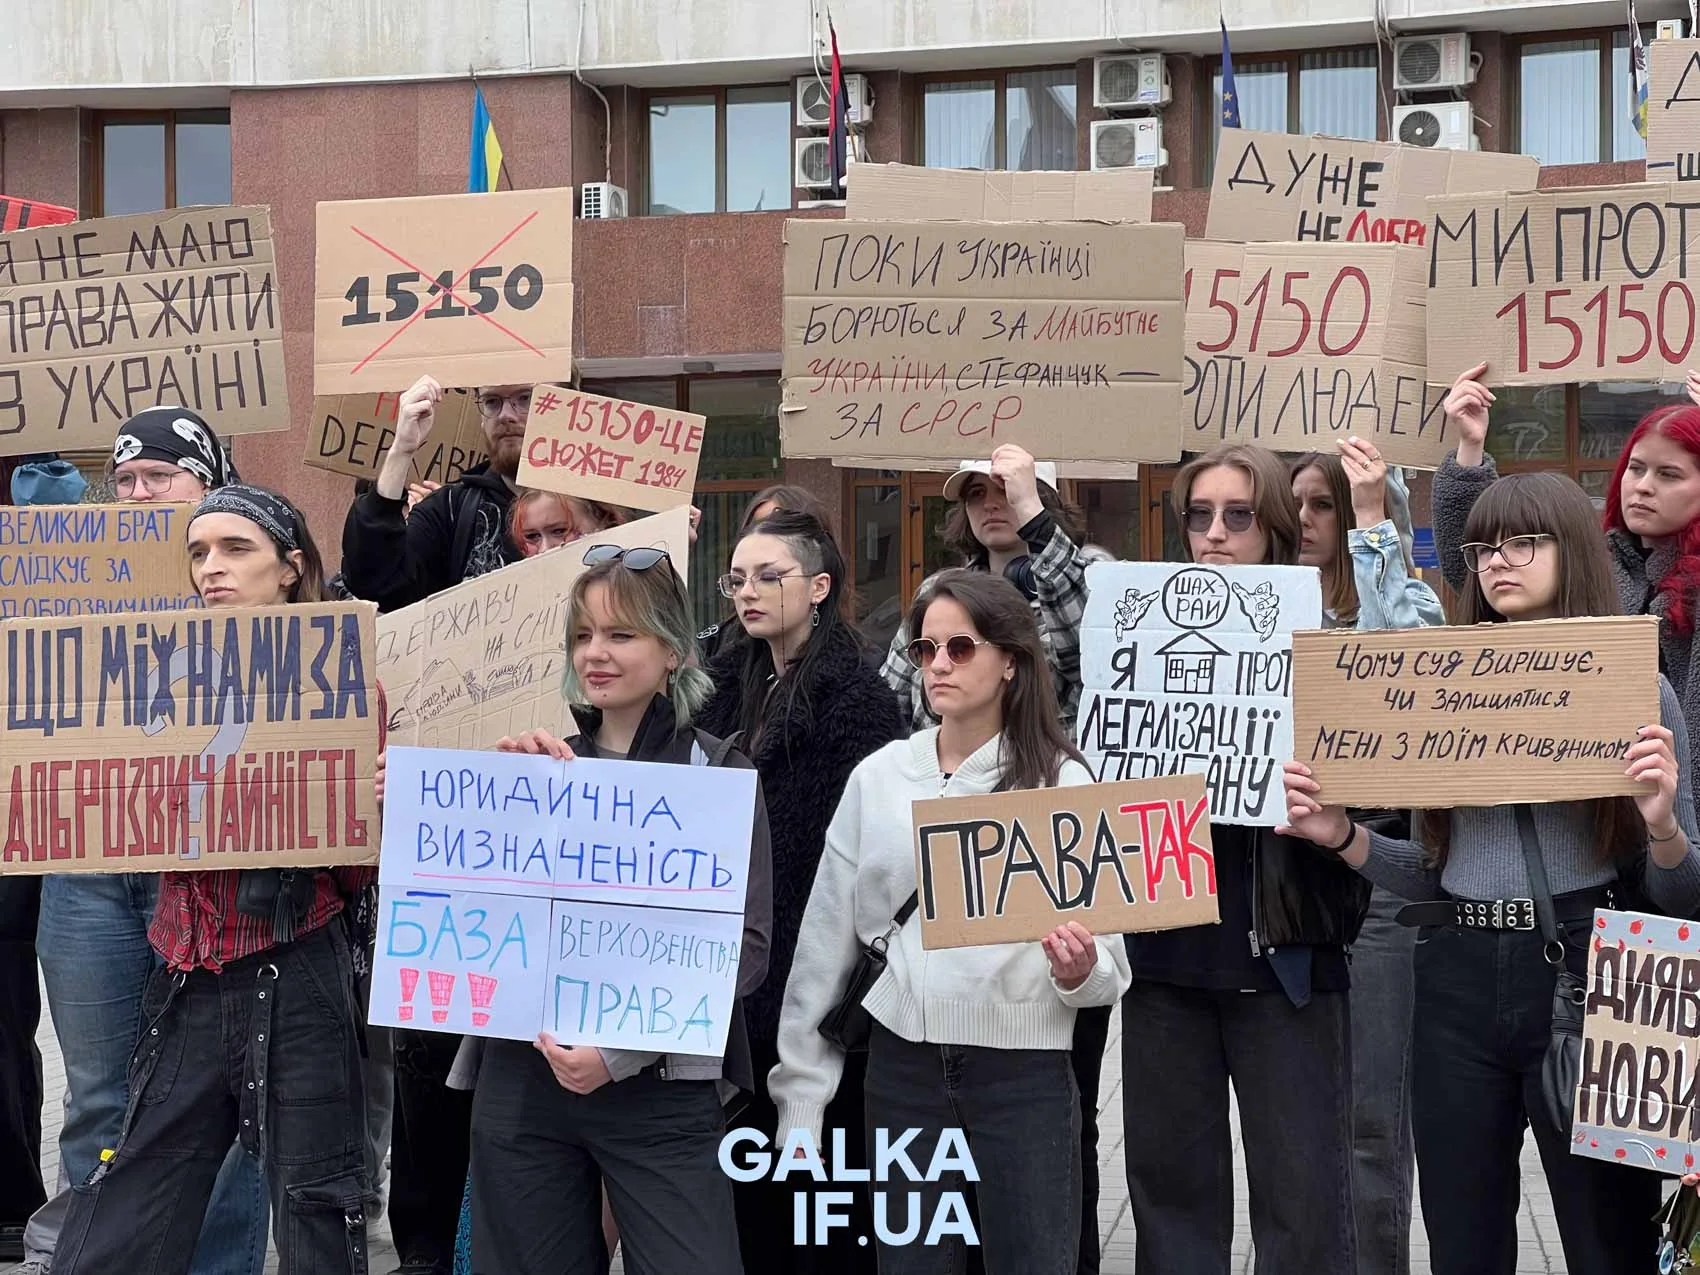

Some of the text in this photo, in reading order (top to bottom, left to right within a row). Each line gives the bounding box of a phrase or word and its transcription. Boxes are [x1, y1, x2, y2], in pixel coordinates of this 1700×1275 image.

[1228, 141, 1384, 207] ДУЖЕ
[35, 232, 104, 281] НЕ
[126, 218, 253, 272] МАЮ
[1298, 210, 1342, 241] НЕ
[1429, 202, 1700, 287] МИ ПРОТ
[814, 234, 1091, 290] ПОКИ УКРАЇНЦІ
[143, 272, 274, 338] ЖИТИ
[342, 263, 543, 326] 15150
[804, 304, 1159, 346] БОРЮТЬСЯ ЗА МАЙБУТНЄ
[1496, 281, 1695, 372] 15150
[46, 338, 267, 429] УКРАЇНІ
[955, 356, 1111, 391] СТЕФАНЧУК
[830, 396, 1022, 440] ЗА СРСР
[528, 436, 687, 487] СЮЖЕТ 1984
[118, 508, 175, 543] БРАТ
[0, 552, 132, 586] СЛІДКУЄ ЗА
[8, 626, 82, 736] ЩО
[186, 616, 300, 726] НАМИ
[310, 614, 368, 719] ЗА
[1111, 641, 1138, 691] Я
[1080, 694, 1281, 756] ЛЕГАЛІЗАЦІЇ
[1311, 726, 1382, 760] МЕНІ
[4, 749, 367, 862] ДОБРОЗВИЧАЙНІСТЬ
[421, 769, 682, 830] ЮРИДИЧНА
[417, 823, 732, 889] ВИЗНАЧЕНІСТЬ
[387, 902, 528, 971] БАЗА
[560, 915, 739, 978] ВЕРХОВЕНСТВА
[555, 975, 712, 1047] ПРАВА
